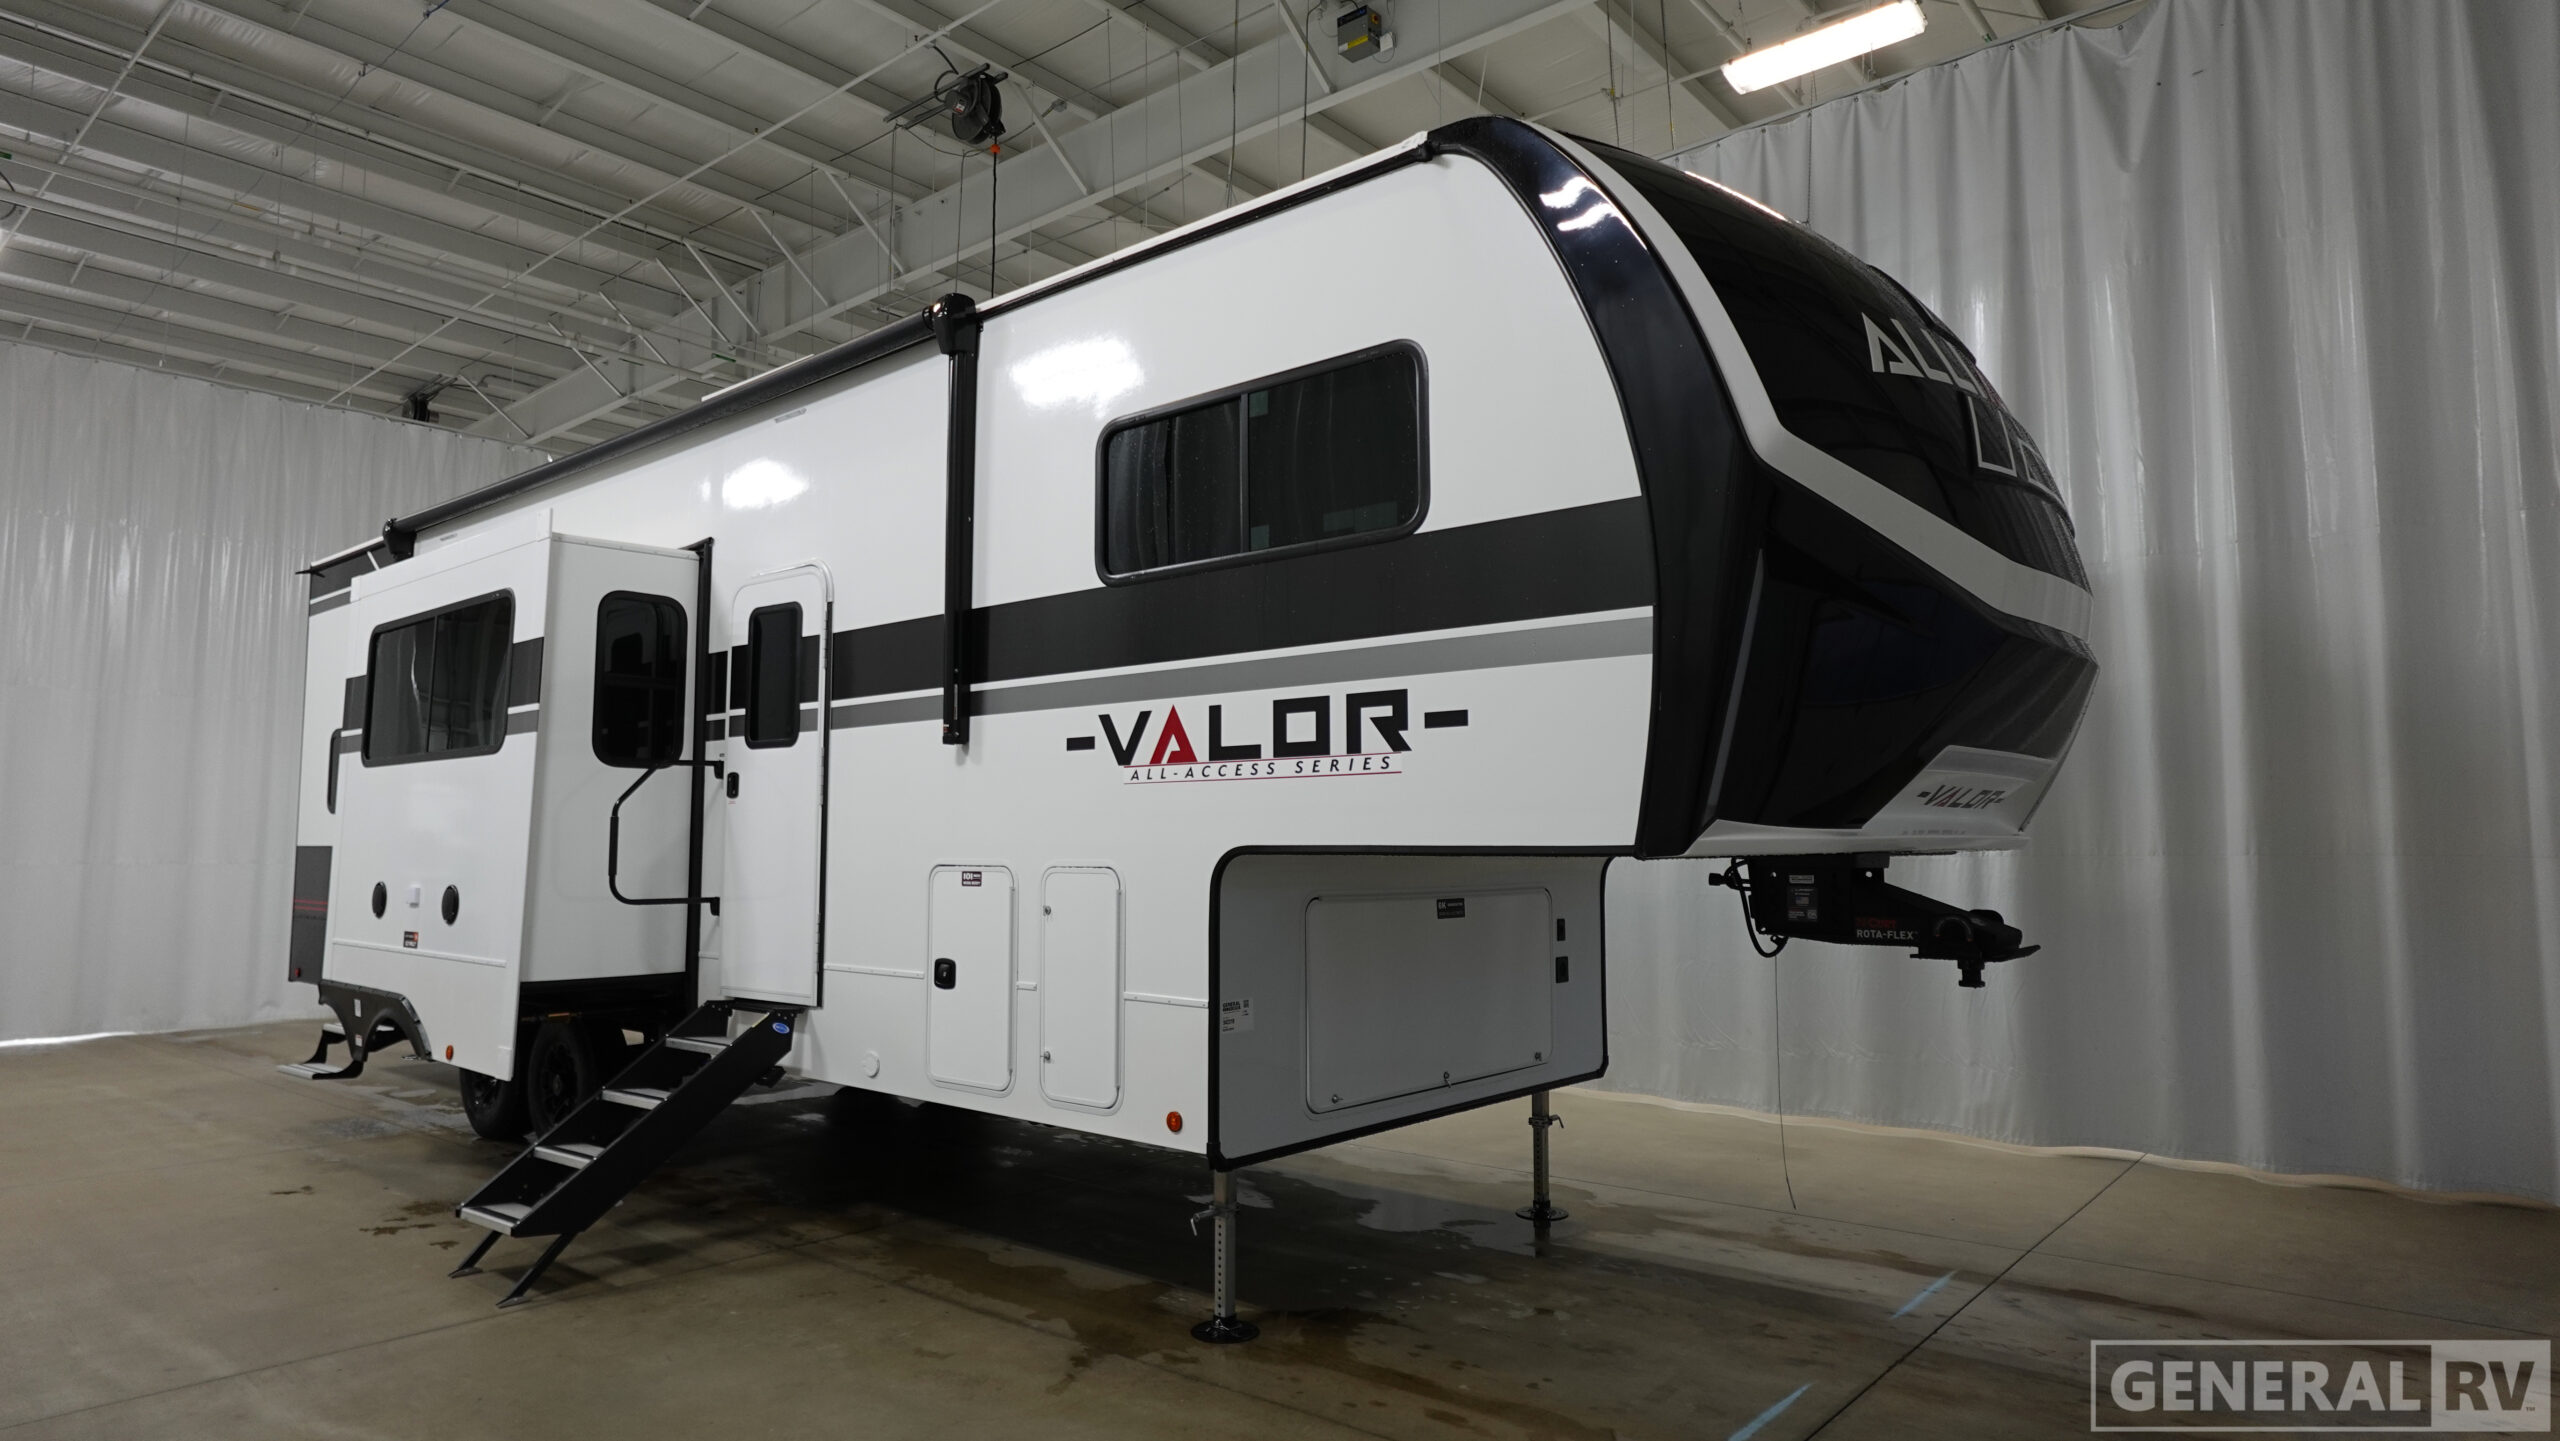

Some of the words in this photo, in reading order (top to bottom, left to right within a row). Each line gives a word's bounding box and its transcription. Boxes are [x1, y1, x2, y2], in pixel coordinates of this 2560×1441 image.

[1130, 762, 1275, 781] ALL-ACCESS
[1294, 756, 1391, 774] SERIES
[1856, 929, 1914, 940] ROTA-FLEX
